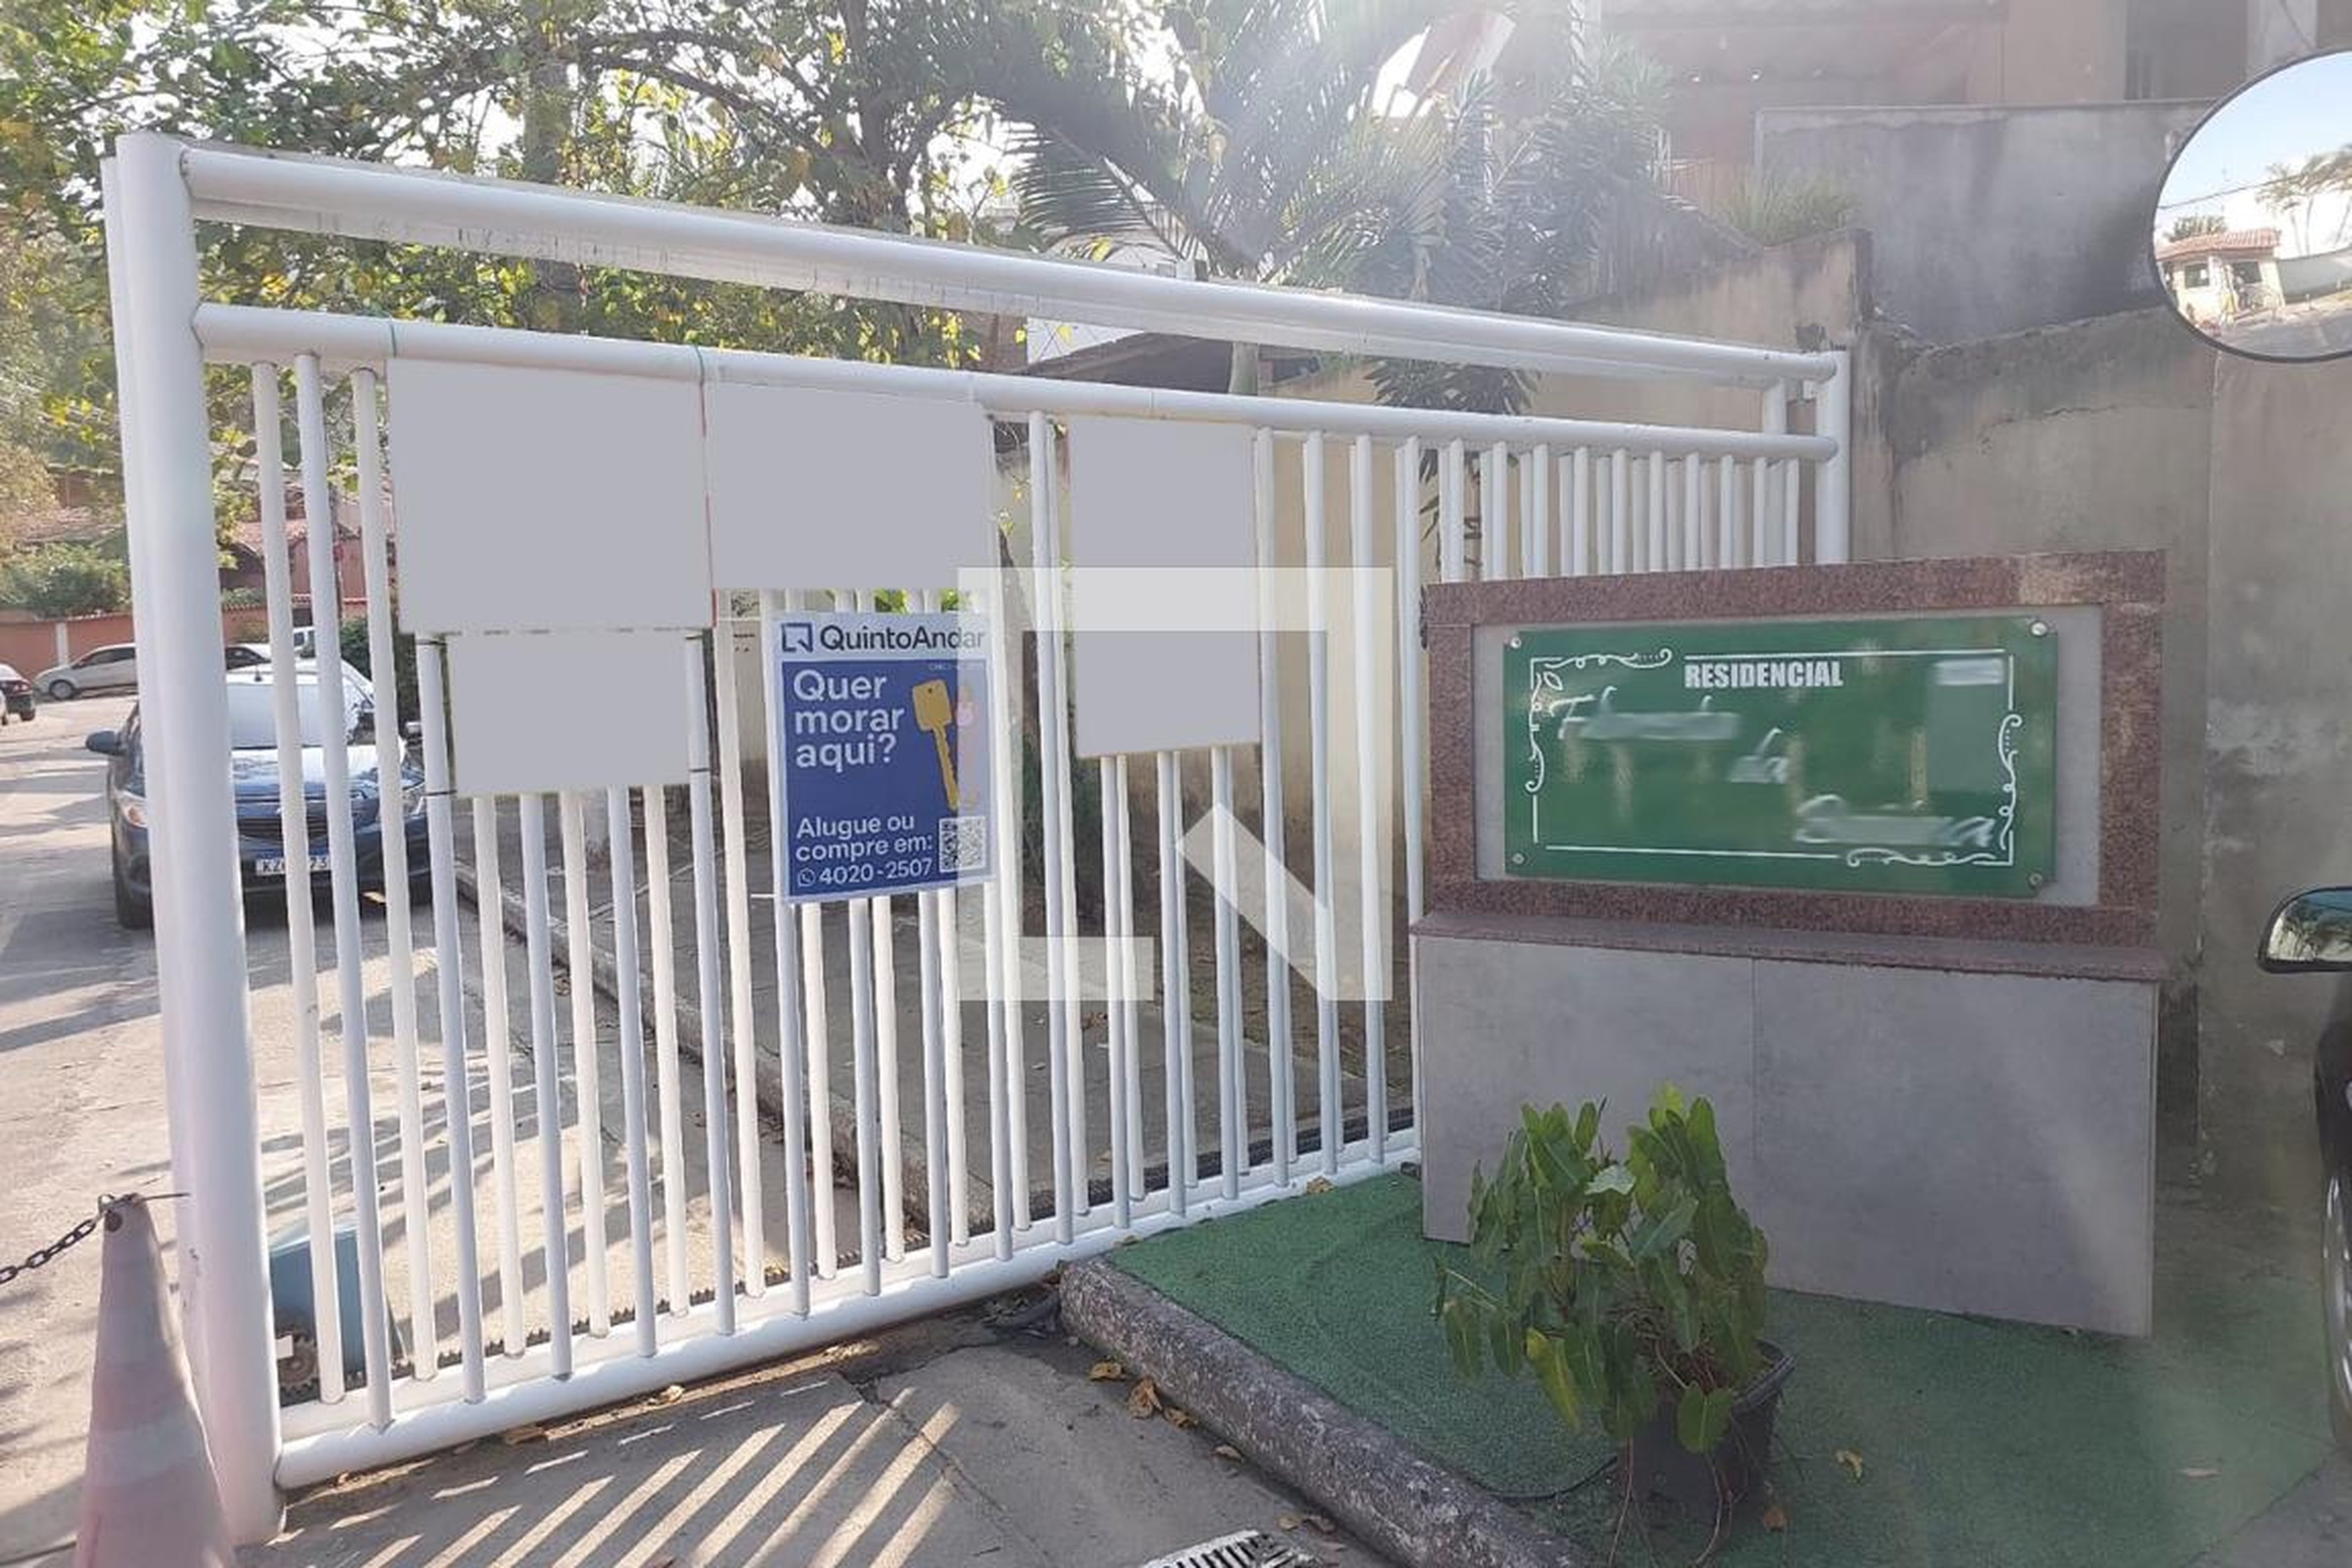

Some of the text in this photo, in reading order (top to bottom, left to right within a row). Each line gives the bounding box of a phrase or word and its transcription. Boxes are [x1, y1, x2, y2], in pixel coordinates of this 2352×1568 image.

[820, 624, 986, 650] QuintoAndar
[794, 669, 887, 701] Quer
[1685, 659, 1844, 688] RESIDENCIAL
[796, 708, 905, 733] morar
[797, 733, 896, 772] aqui?
[797, 815, 915, 840] Alugue ou
[796, 835, 933, 861] compre em:
